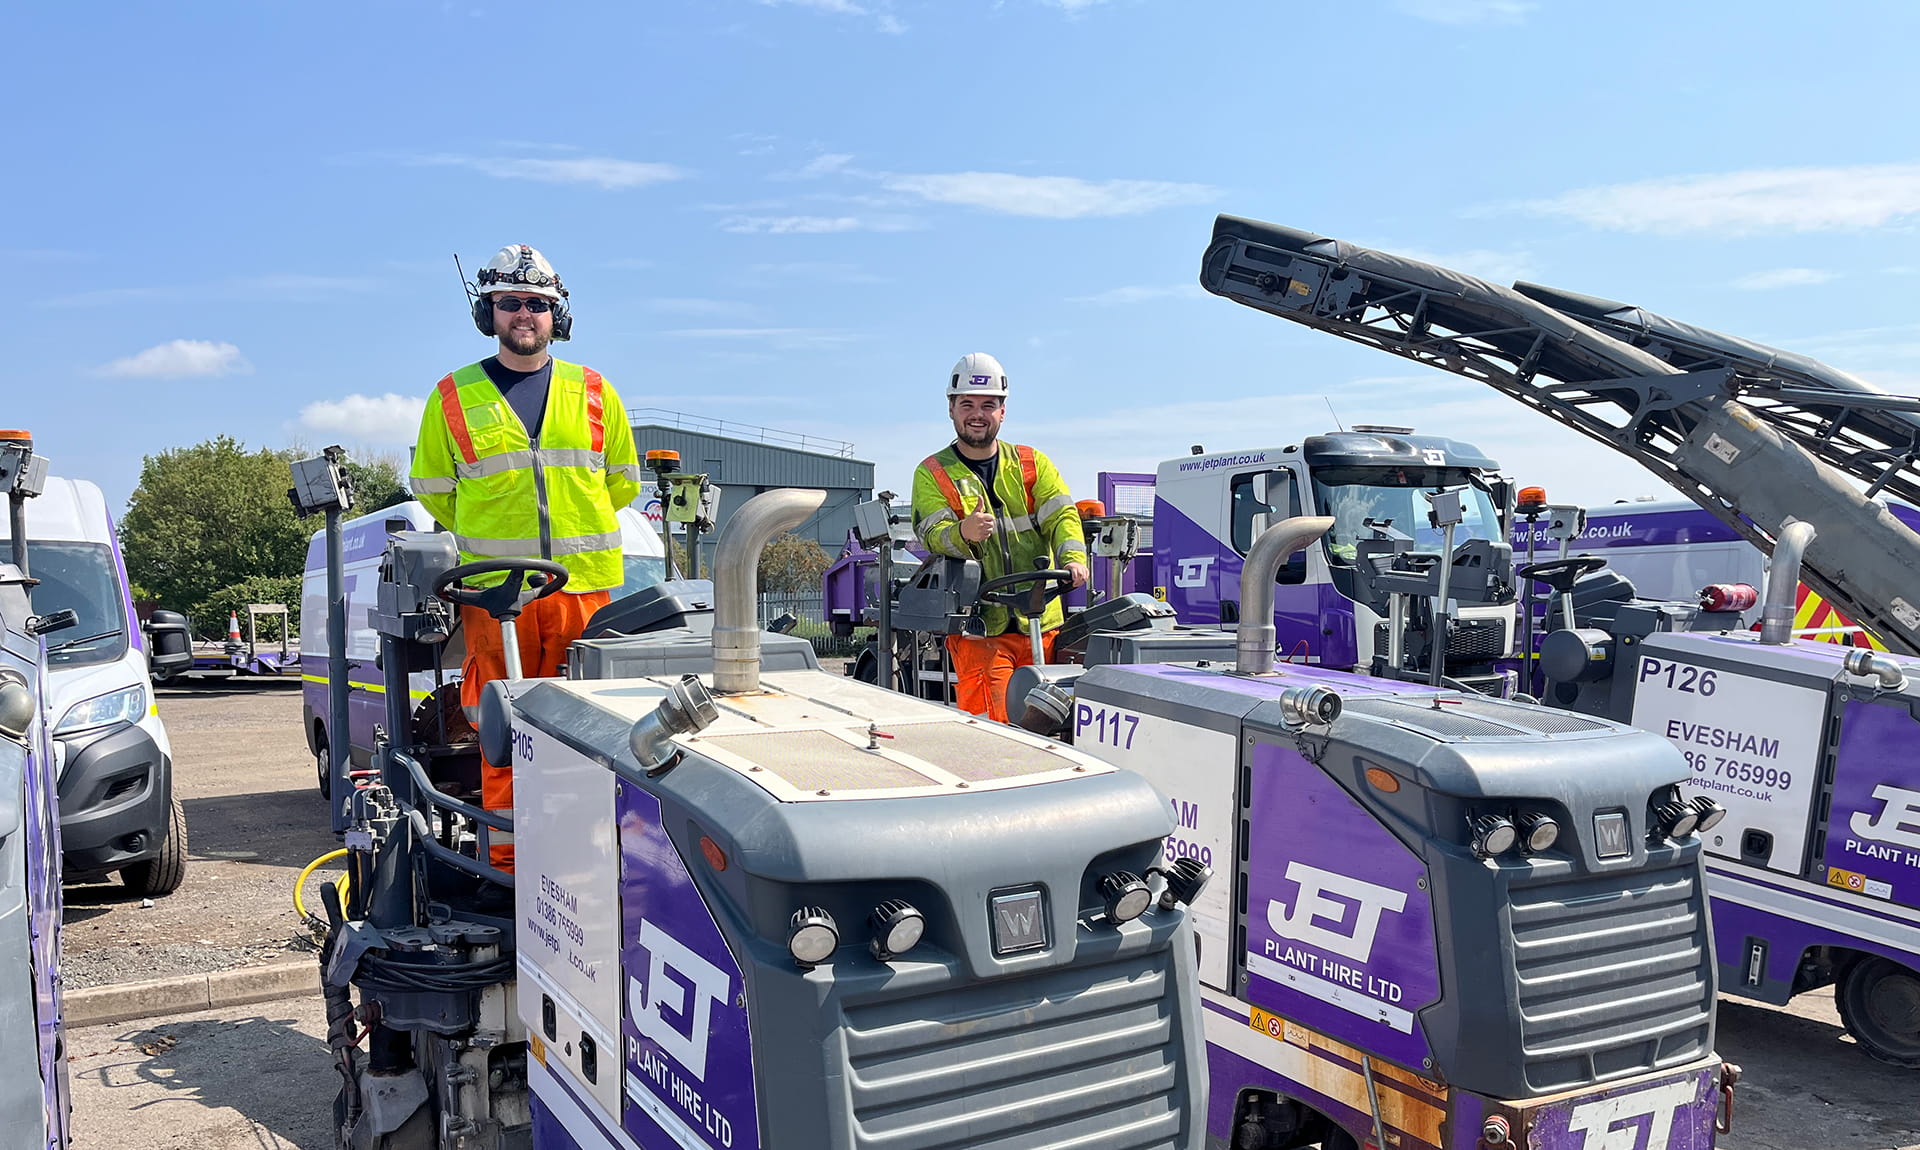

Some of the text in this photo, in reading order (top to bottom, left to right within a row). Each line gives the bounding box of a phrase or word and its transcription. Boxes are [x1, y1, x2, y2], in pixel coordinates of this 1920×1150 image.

[969, 375, 991, 385] JET
[1180, 452, 1265, 472] www.jetplant.co.uk
[1422, 449, 1446, 466] JET
[1174, 556, 1215, 588] JET
[1639, 657, 1718, 697] P126
[512, 728, 534, 762] P105
[1076, 703, 1140, 750] P117
[1666, 719, 1779, 760] EVESHAM
[1714, 757, 1791, 791] 765999
[1849, 784, 1920, 850] JE
[1845, 839, 1902, 863] PLANT
[1267, 860, 1408, 964] JET
[1265, 938, 1318, 972] PLANT
[1322, 958, 1363, 990] HIRE
[1367, 975, 1402, 1003] LTD
[629, 917, 730, 1083] JET
[629, 1035, 732, 1149] PLANT HIRE LTD
